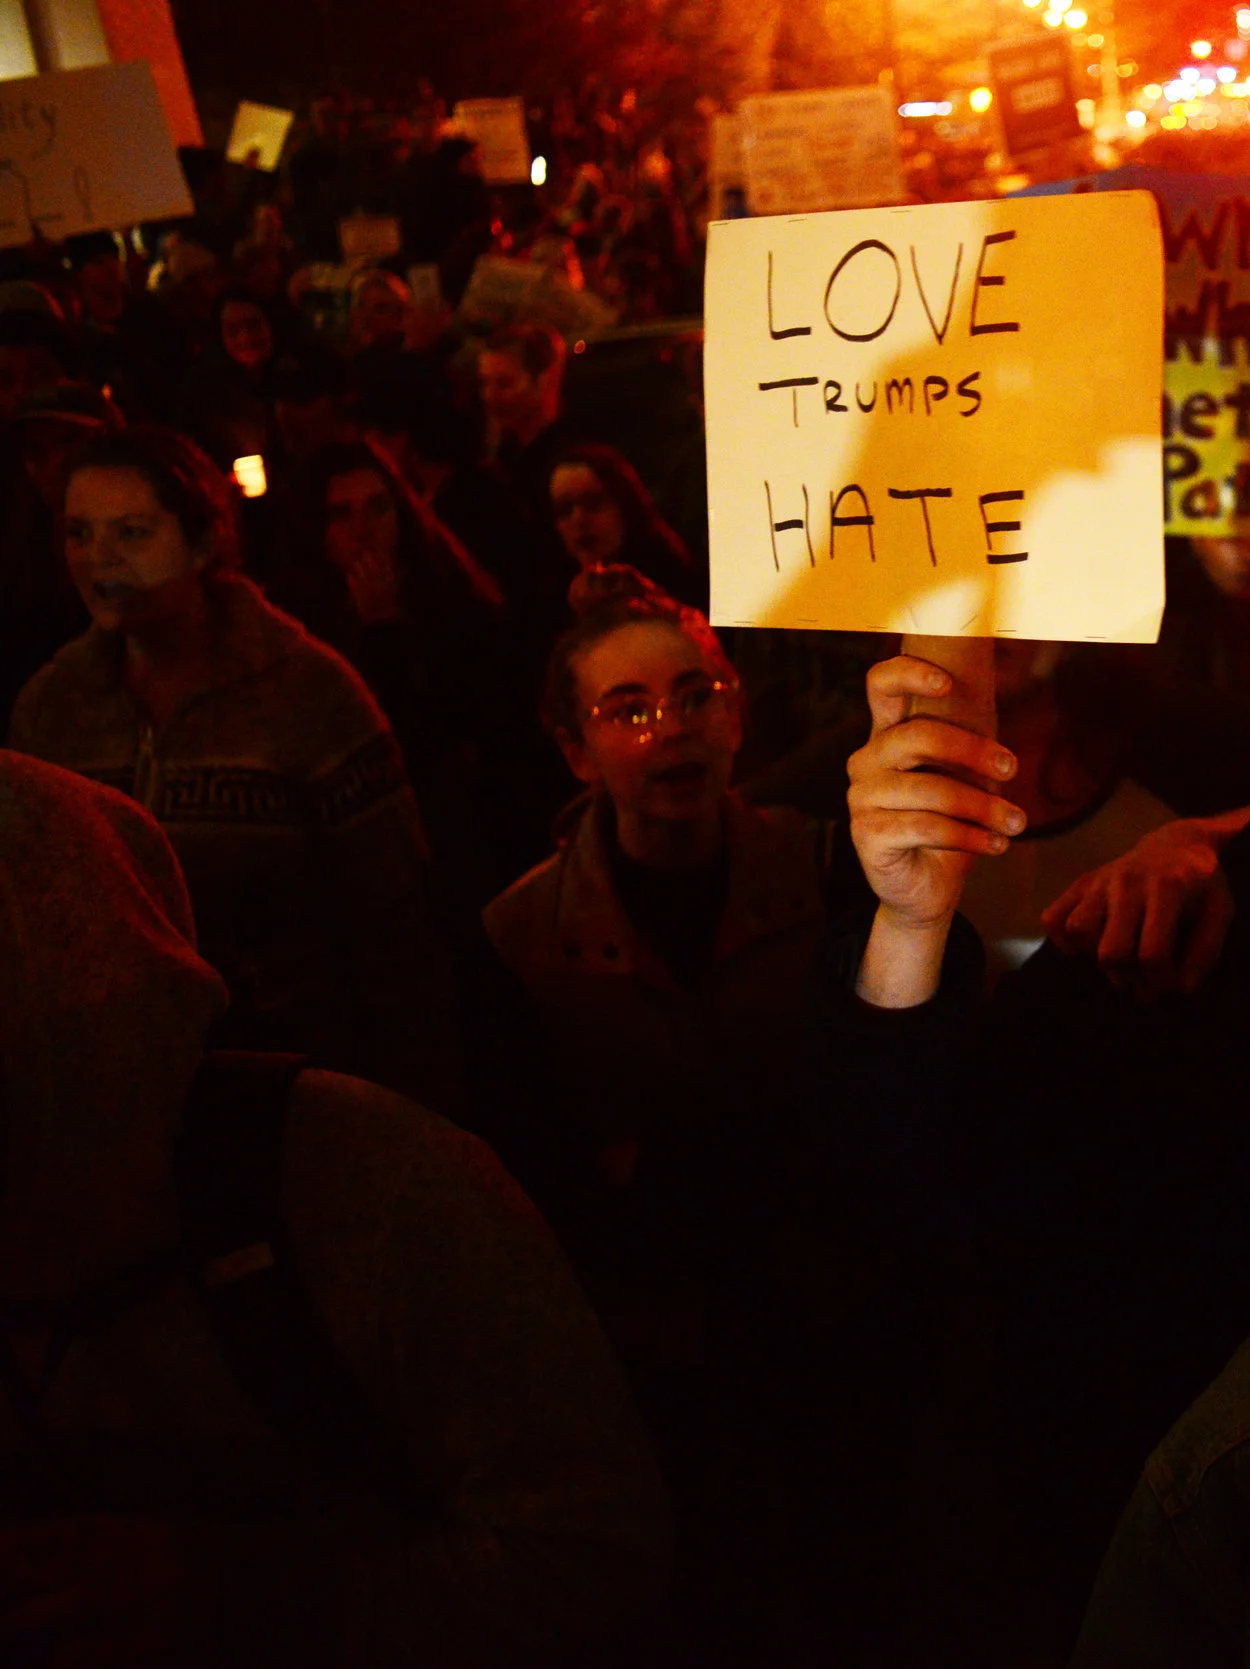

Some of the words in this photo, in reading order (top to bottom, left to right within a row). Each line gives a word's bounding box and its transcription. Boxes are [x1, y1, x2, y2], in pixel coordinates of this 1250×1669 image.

[767, 230, 1020, 345] LOVE
[758, 371, 983, 428] TRUMPS
[764, 480, 1029, 573] HATE
